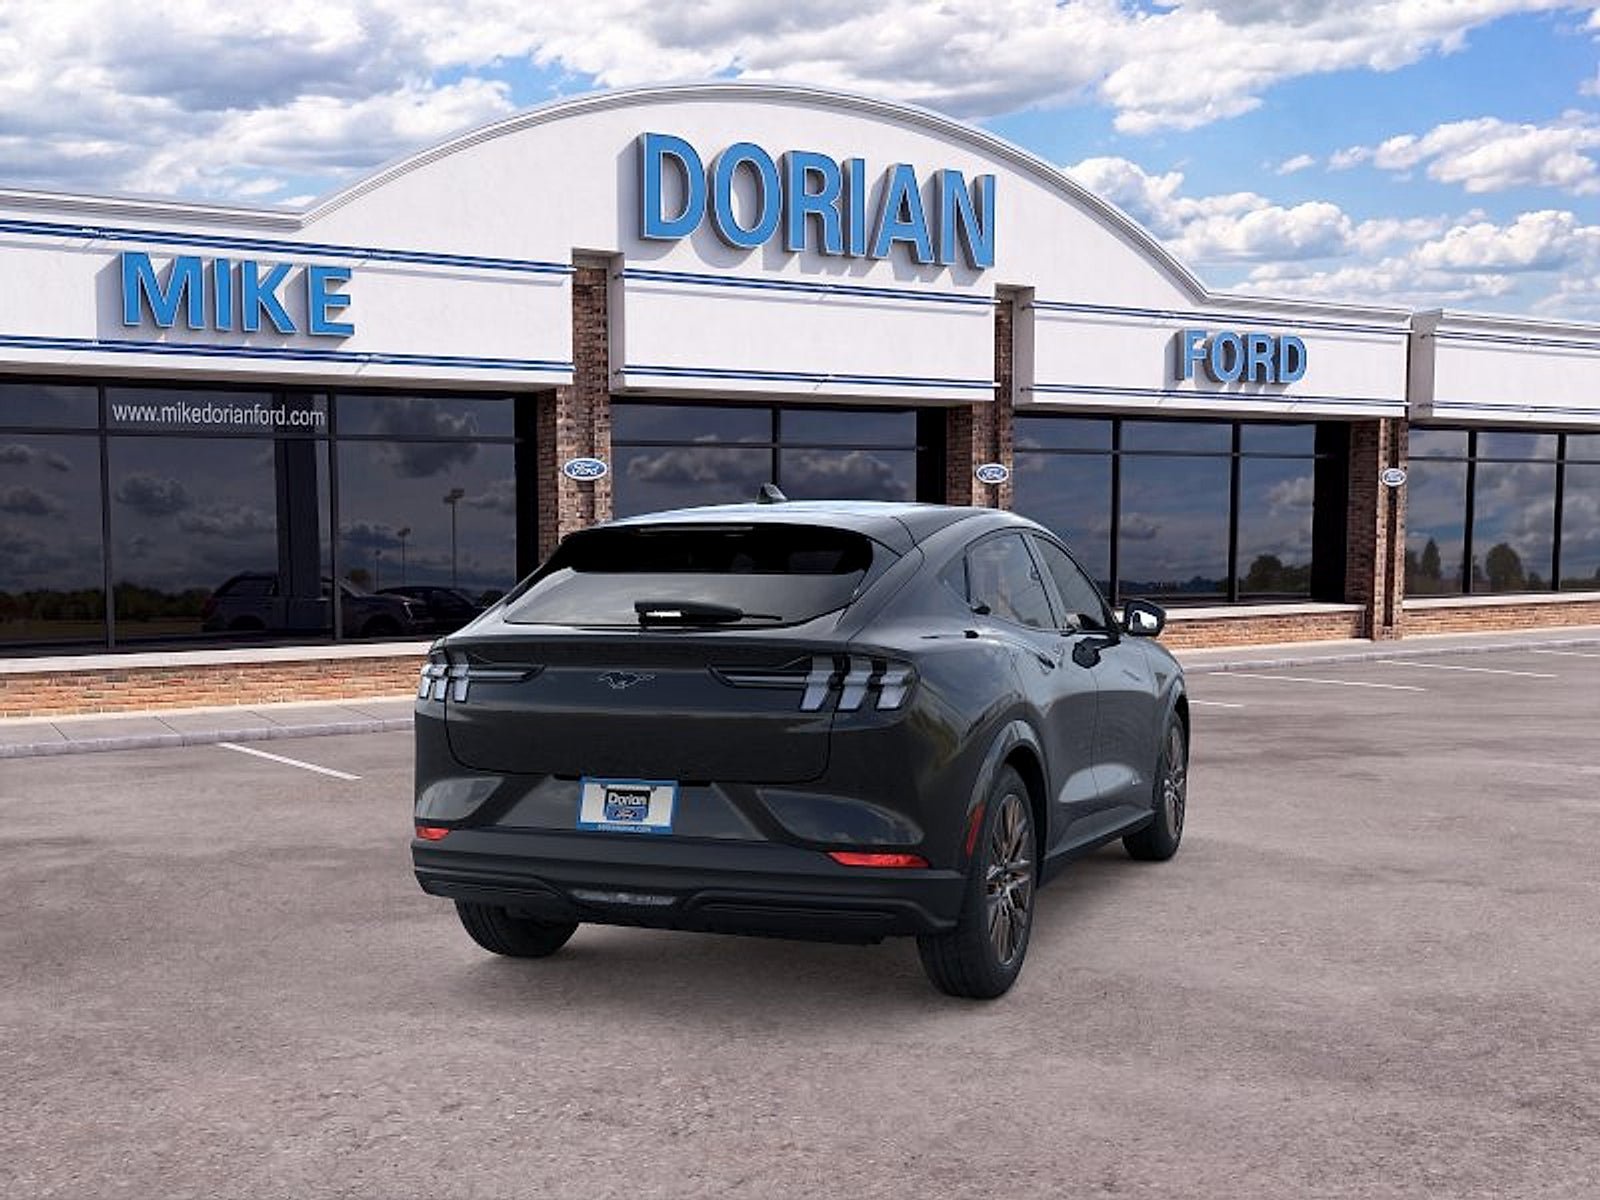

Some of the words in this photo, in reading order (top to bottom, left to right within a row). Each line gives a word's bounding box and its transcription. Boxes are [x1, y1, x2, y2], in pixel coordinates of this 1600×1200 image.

[640, 132, 996, 269] DORIAN
[121, 251, 355, 338] MIKE
[1177, 328, 1308, 384] FORD
[112, 402, 326, 427] www.mikedorianford.com
[608, 792, 648, 806] Dorian
